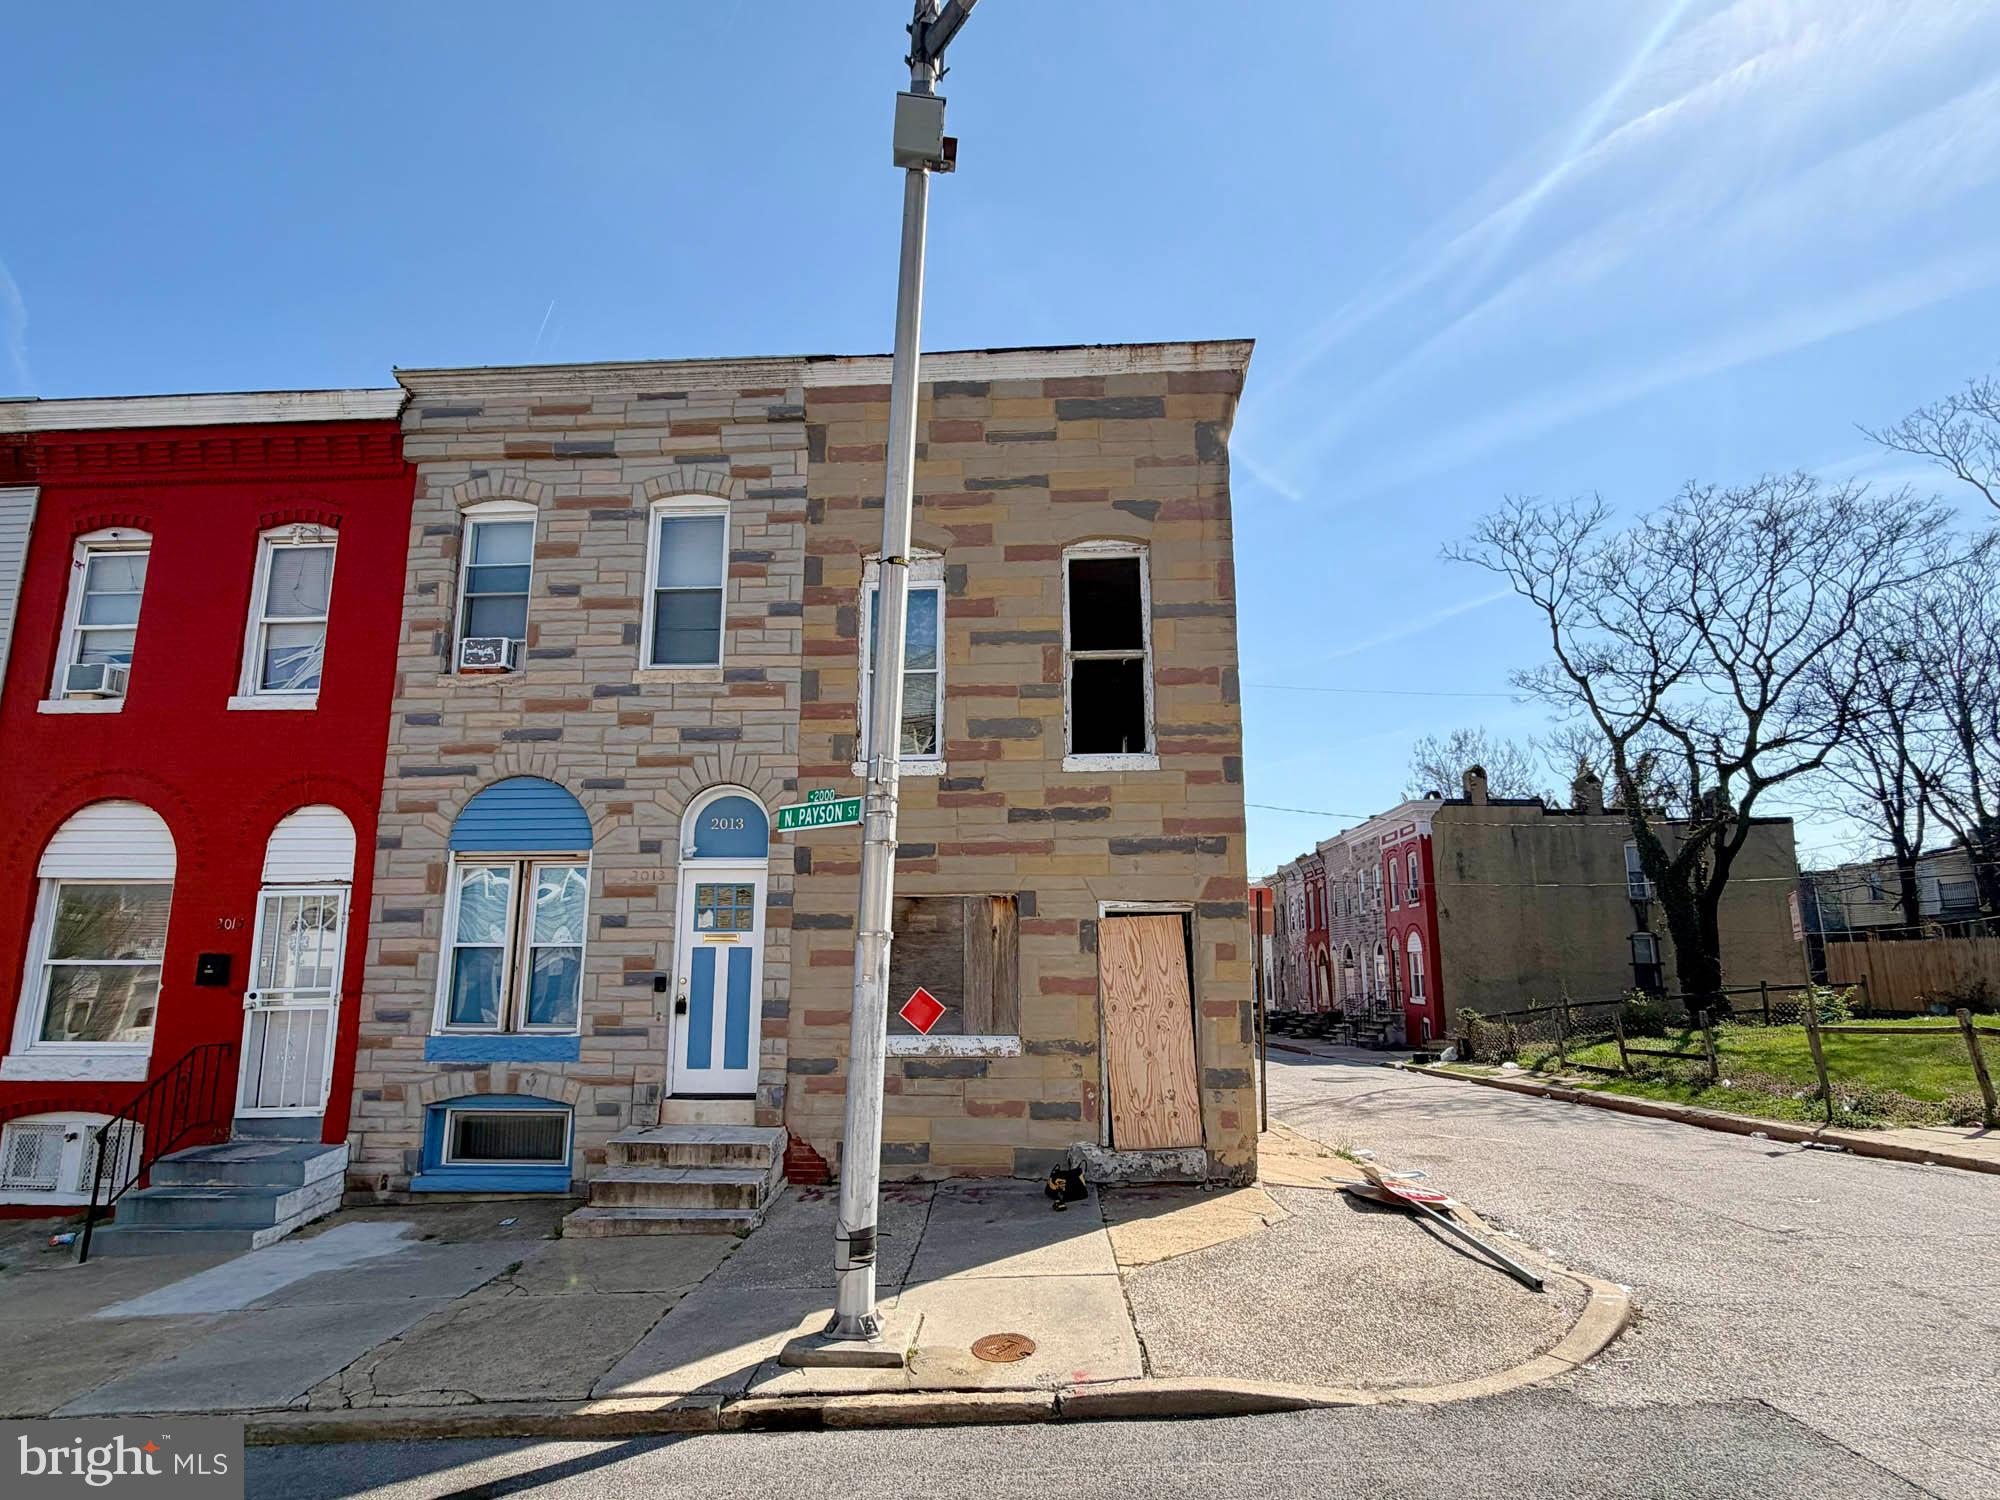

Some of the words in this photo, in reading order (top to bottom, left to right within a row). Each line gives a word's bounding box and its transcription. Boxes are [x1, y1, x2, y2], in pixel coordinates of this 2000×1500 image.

[814, 790, 834, 802] 2000
[785, 810, 795, 827] N.
[799, 804, 843, 825] PAYSON
[848, 806, 857, 817] ST.
[711, 818, 744, 830] 2013
[631, 870, 665, 881] 2013
[217, 917, 244, 930] 201
